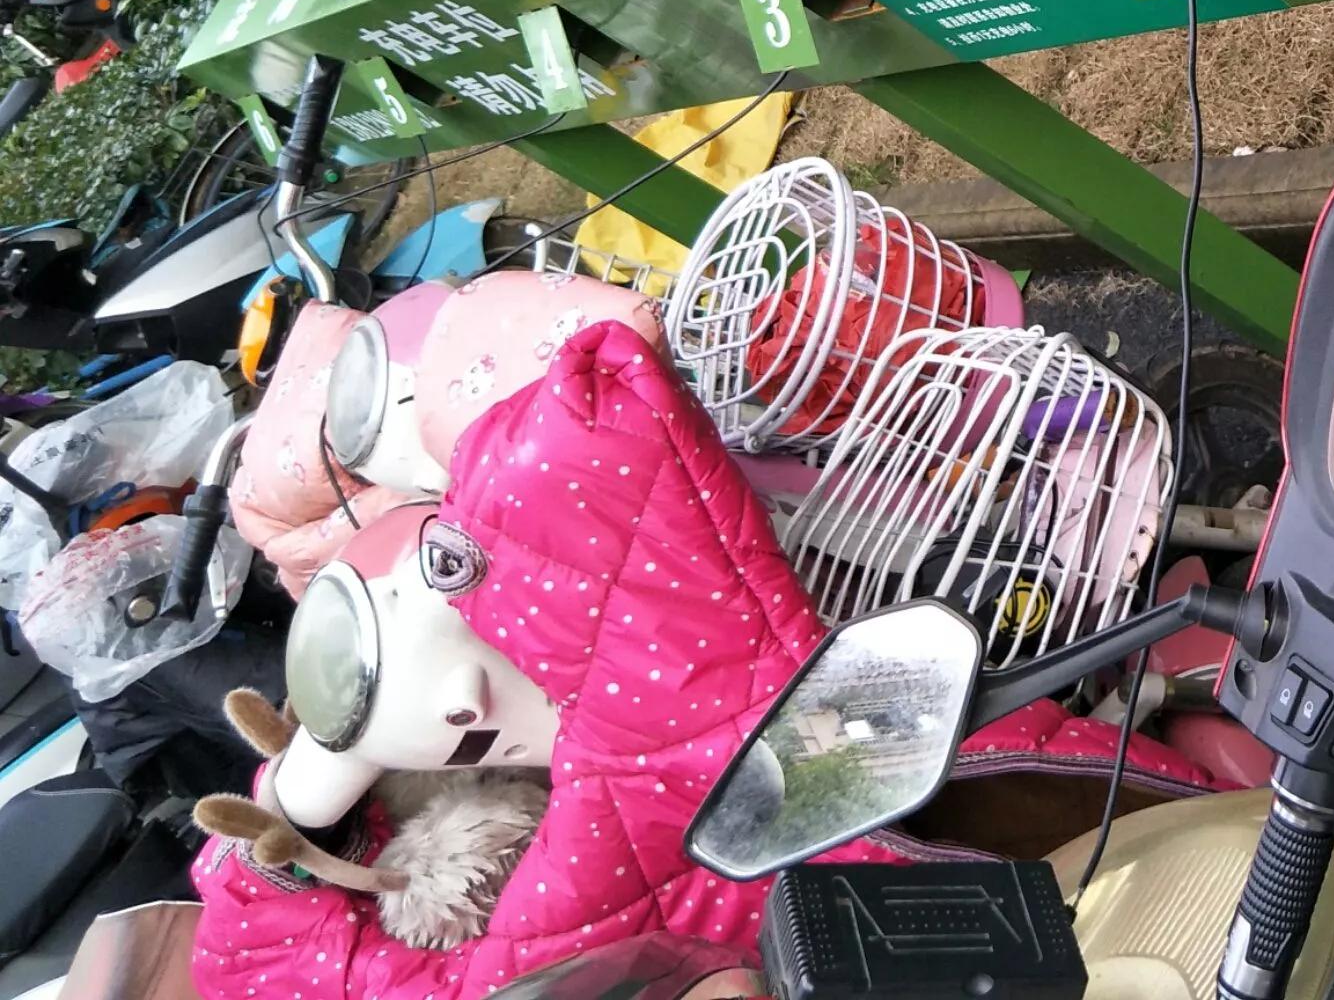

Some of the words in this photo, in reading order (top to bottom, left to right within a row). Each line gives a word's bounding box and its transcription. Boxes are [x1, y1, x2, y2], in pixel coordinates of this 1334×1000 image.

[359, 0, 520, 67] 充电车位
[540, 28, 568, 90] 4
[373, 75, 408, 125] 5
